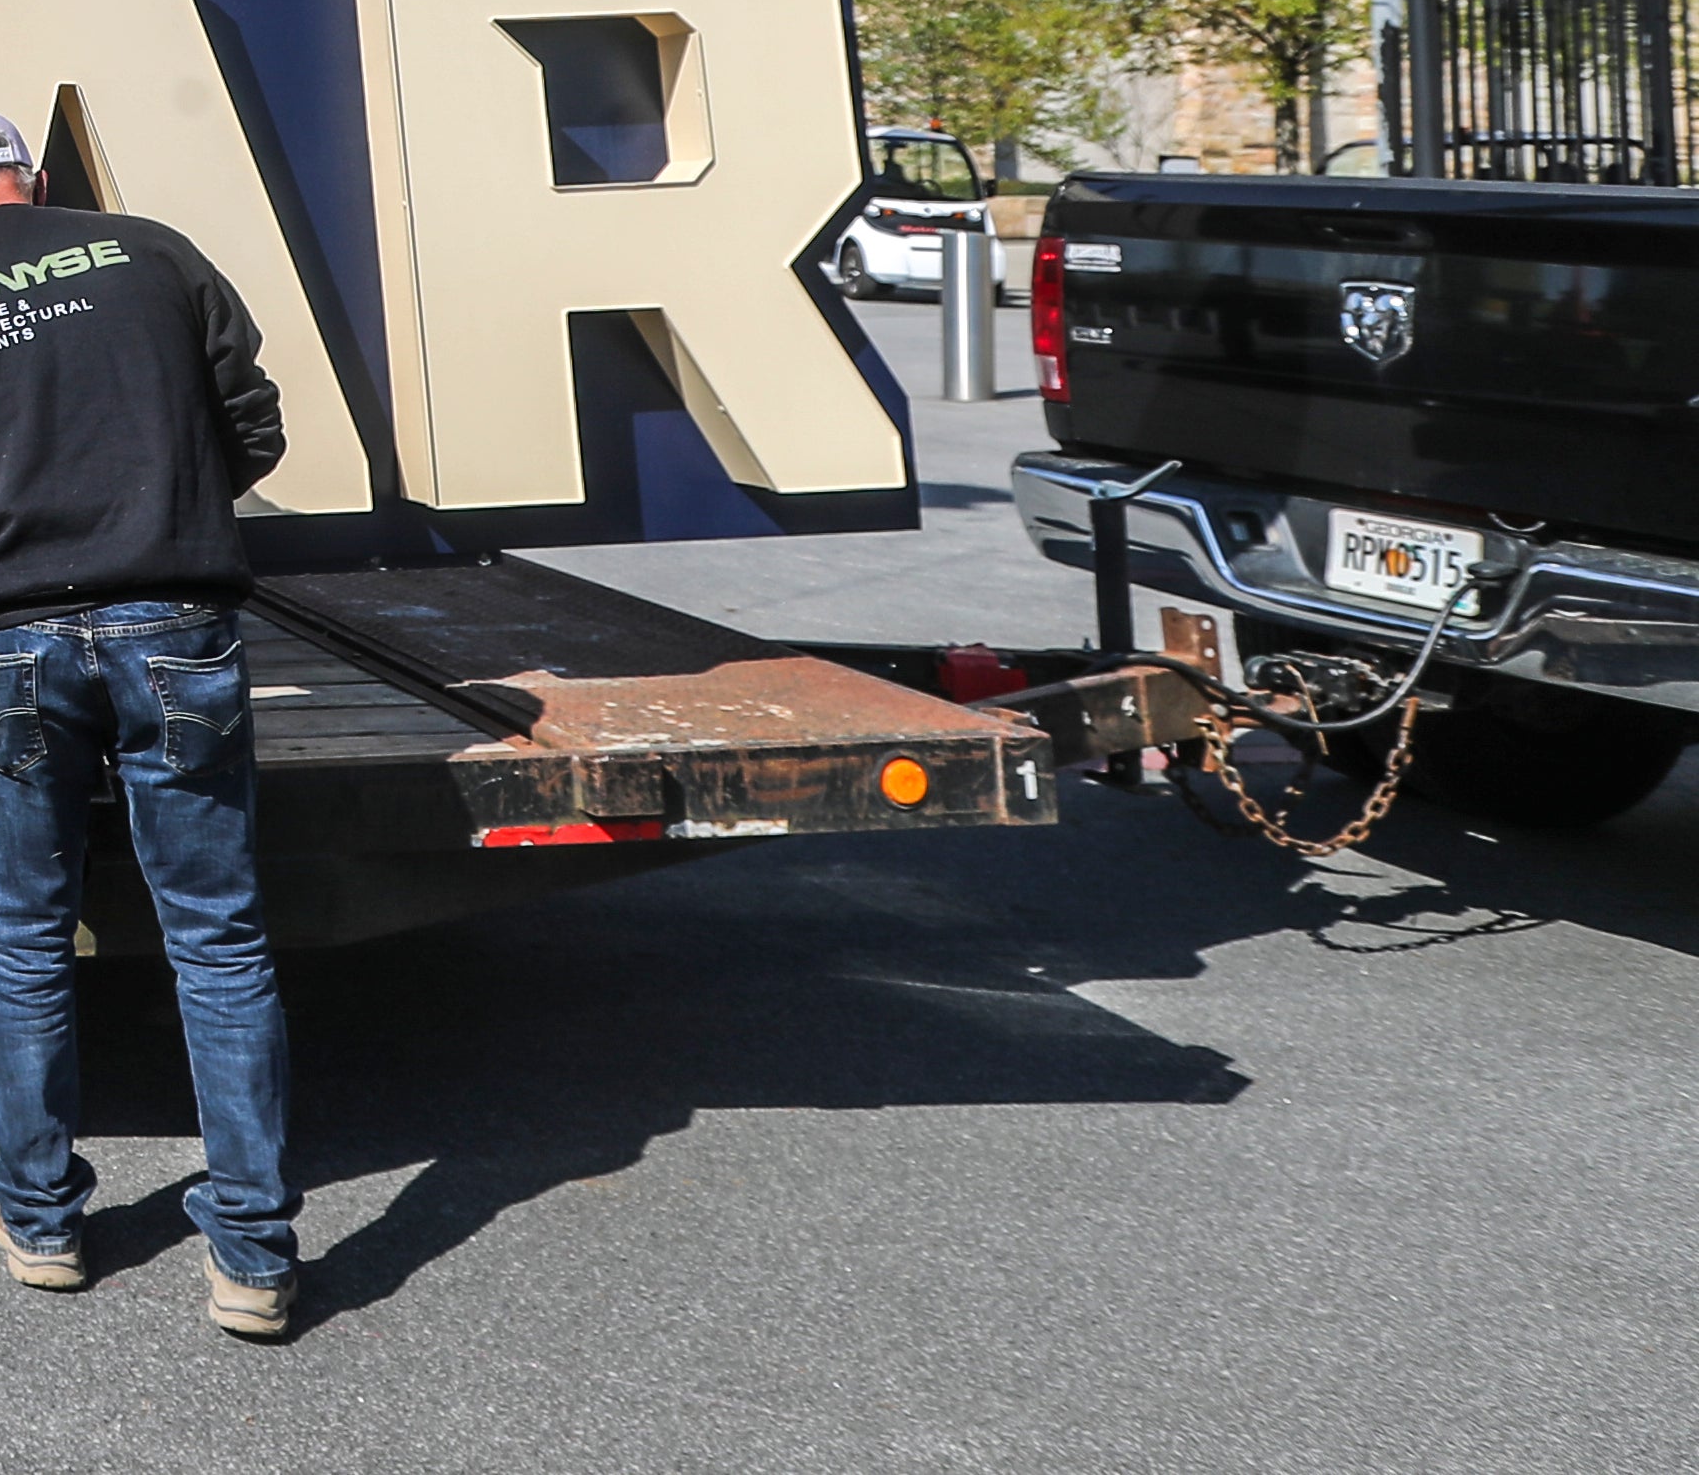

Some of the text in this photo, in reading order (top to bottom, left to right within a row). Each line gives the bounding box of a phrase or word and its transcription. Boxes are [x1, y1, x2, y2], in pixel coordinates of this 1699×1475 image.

[17, 299, 31, 312] &
[1364, 519, 1445, 544] GEORGIA
[1015, 759, 1038, 800] 1
